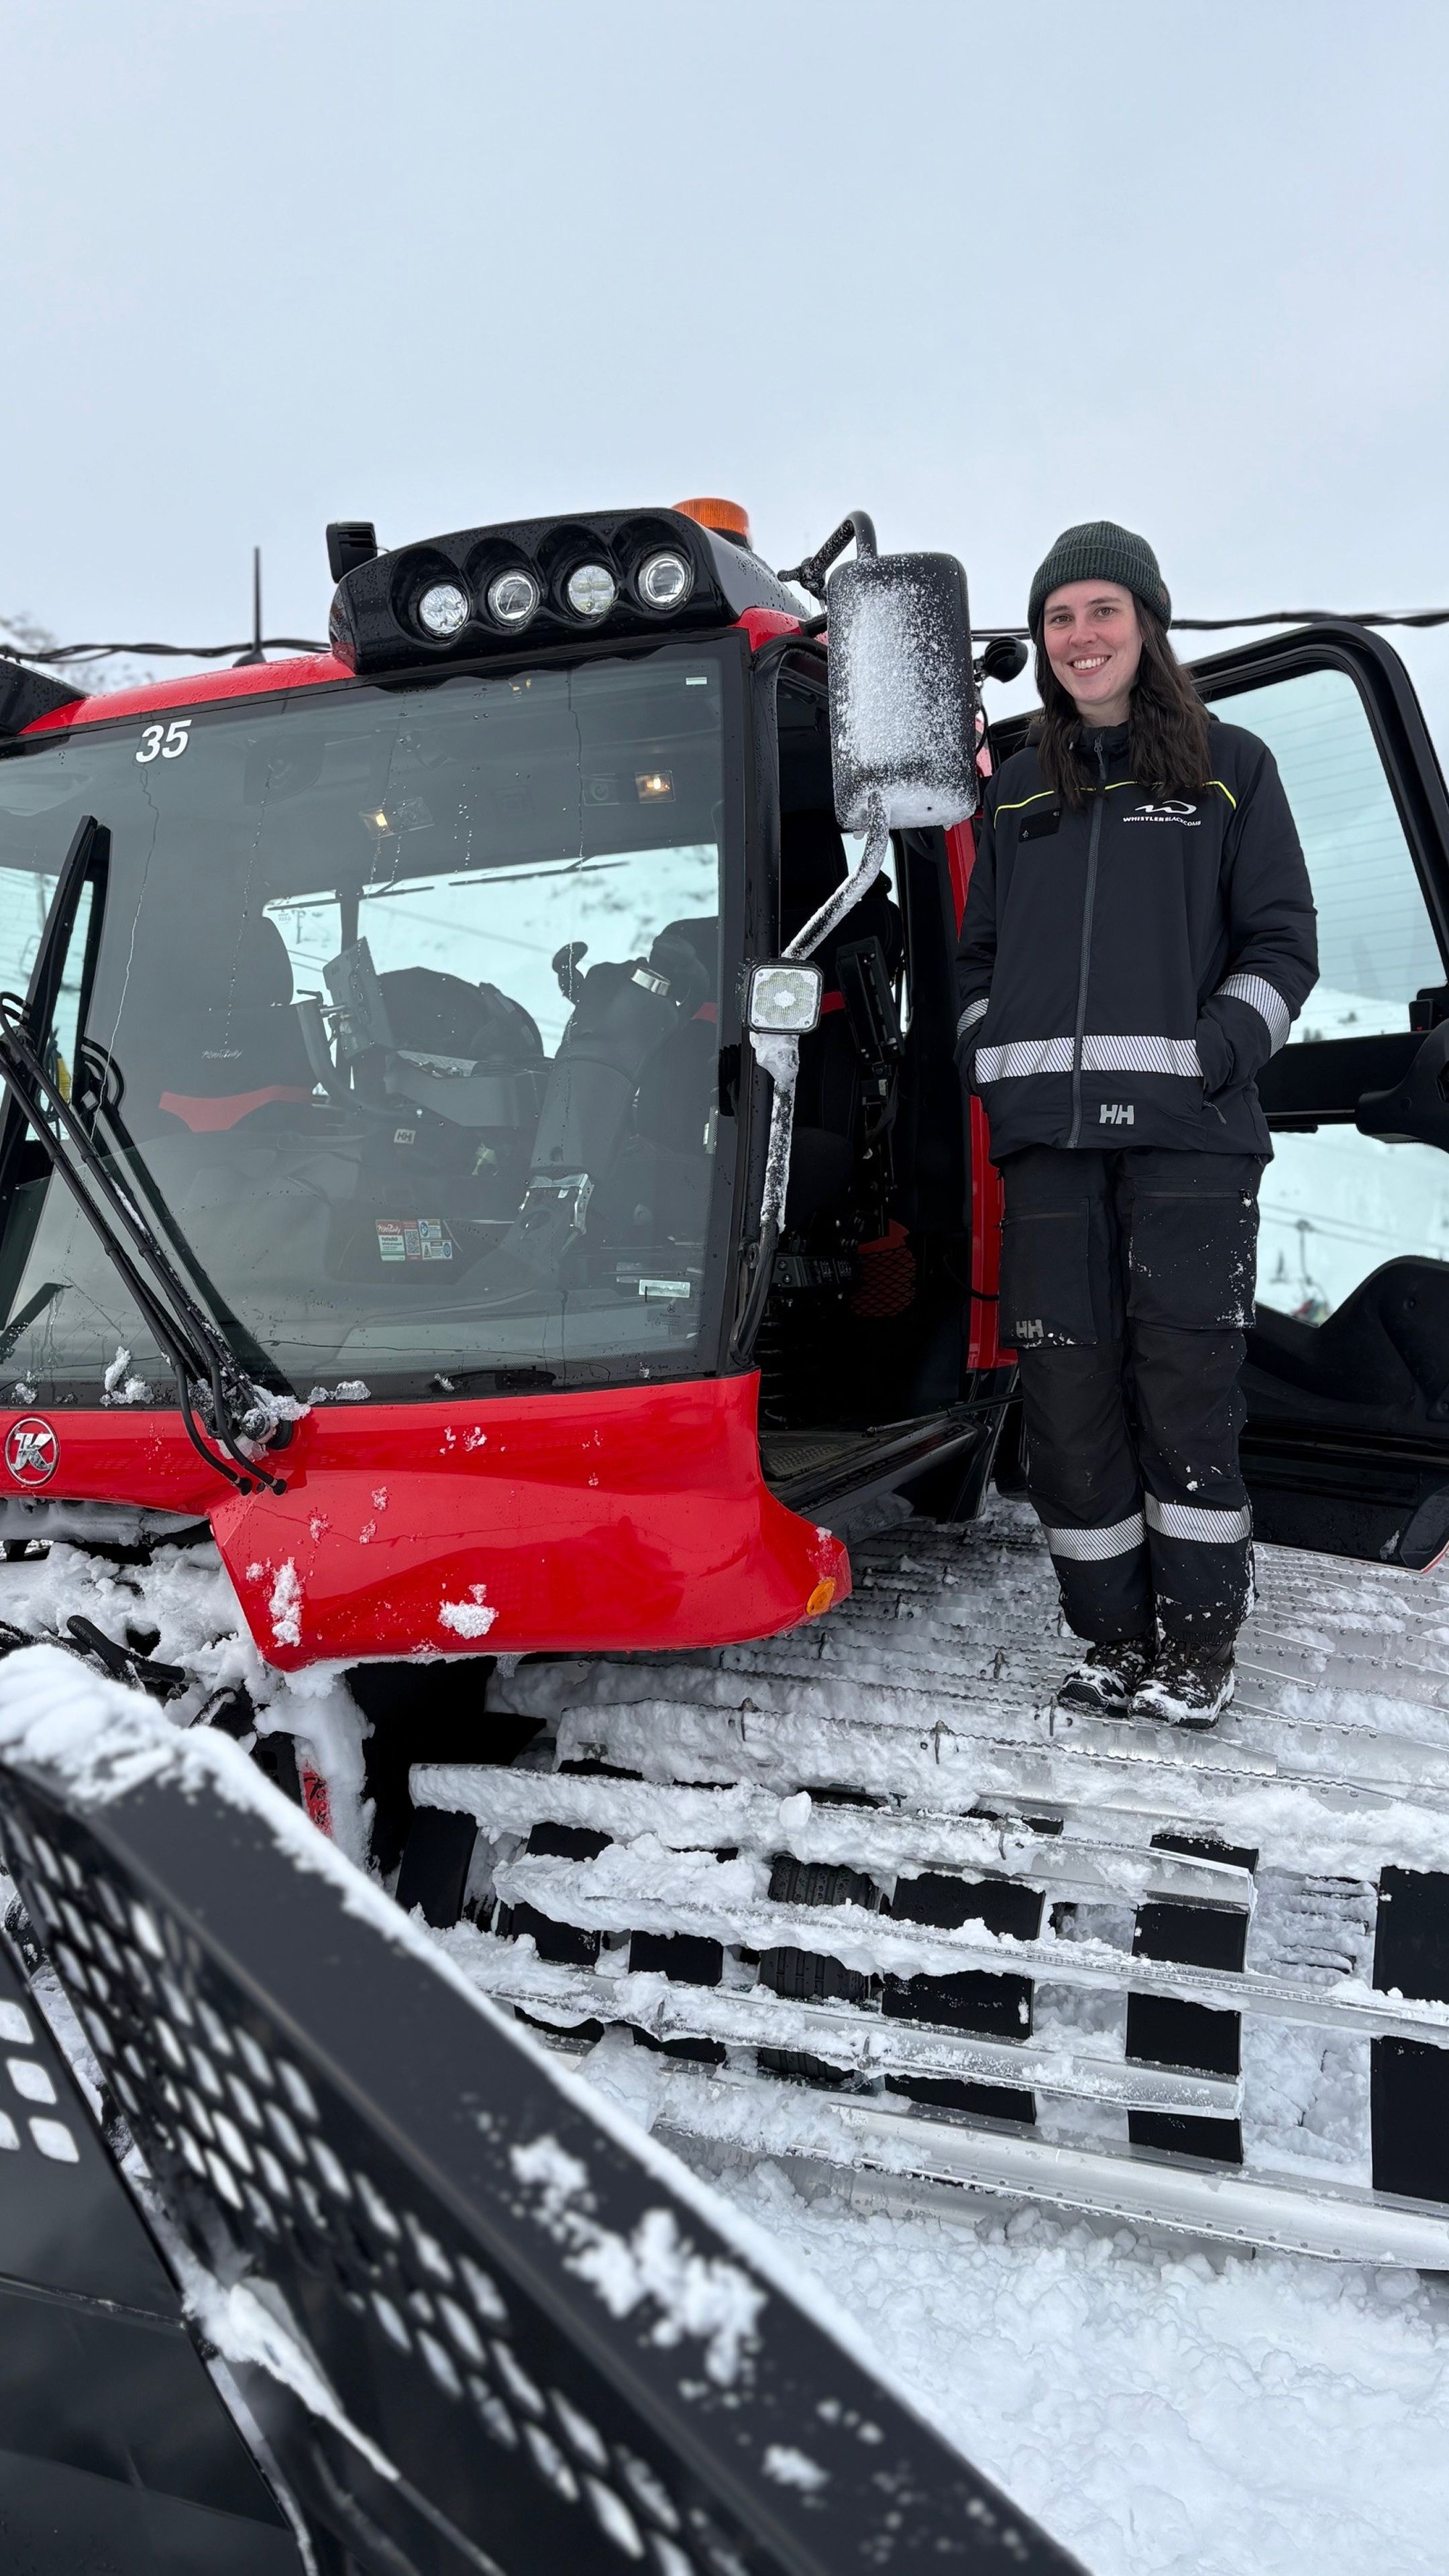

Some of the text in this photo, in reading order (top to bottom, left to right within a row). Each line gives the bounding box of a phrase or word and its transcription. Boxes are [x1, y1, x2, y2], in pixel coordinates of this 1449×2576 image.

[136, 720, 192, 762] 35
[1099, 1104, 1134, 1125] HH
[1016, 1319, 1044, 1339] HH
